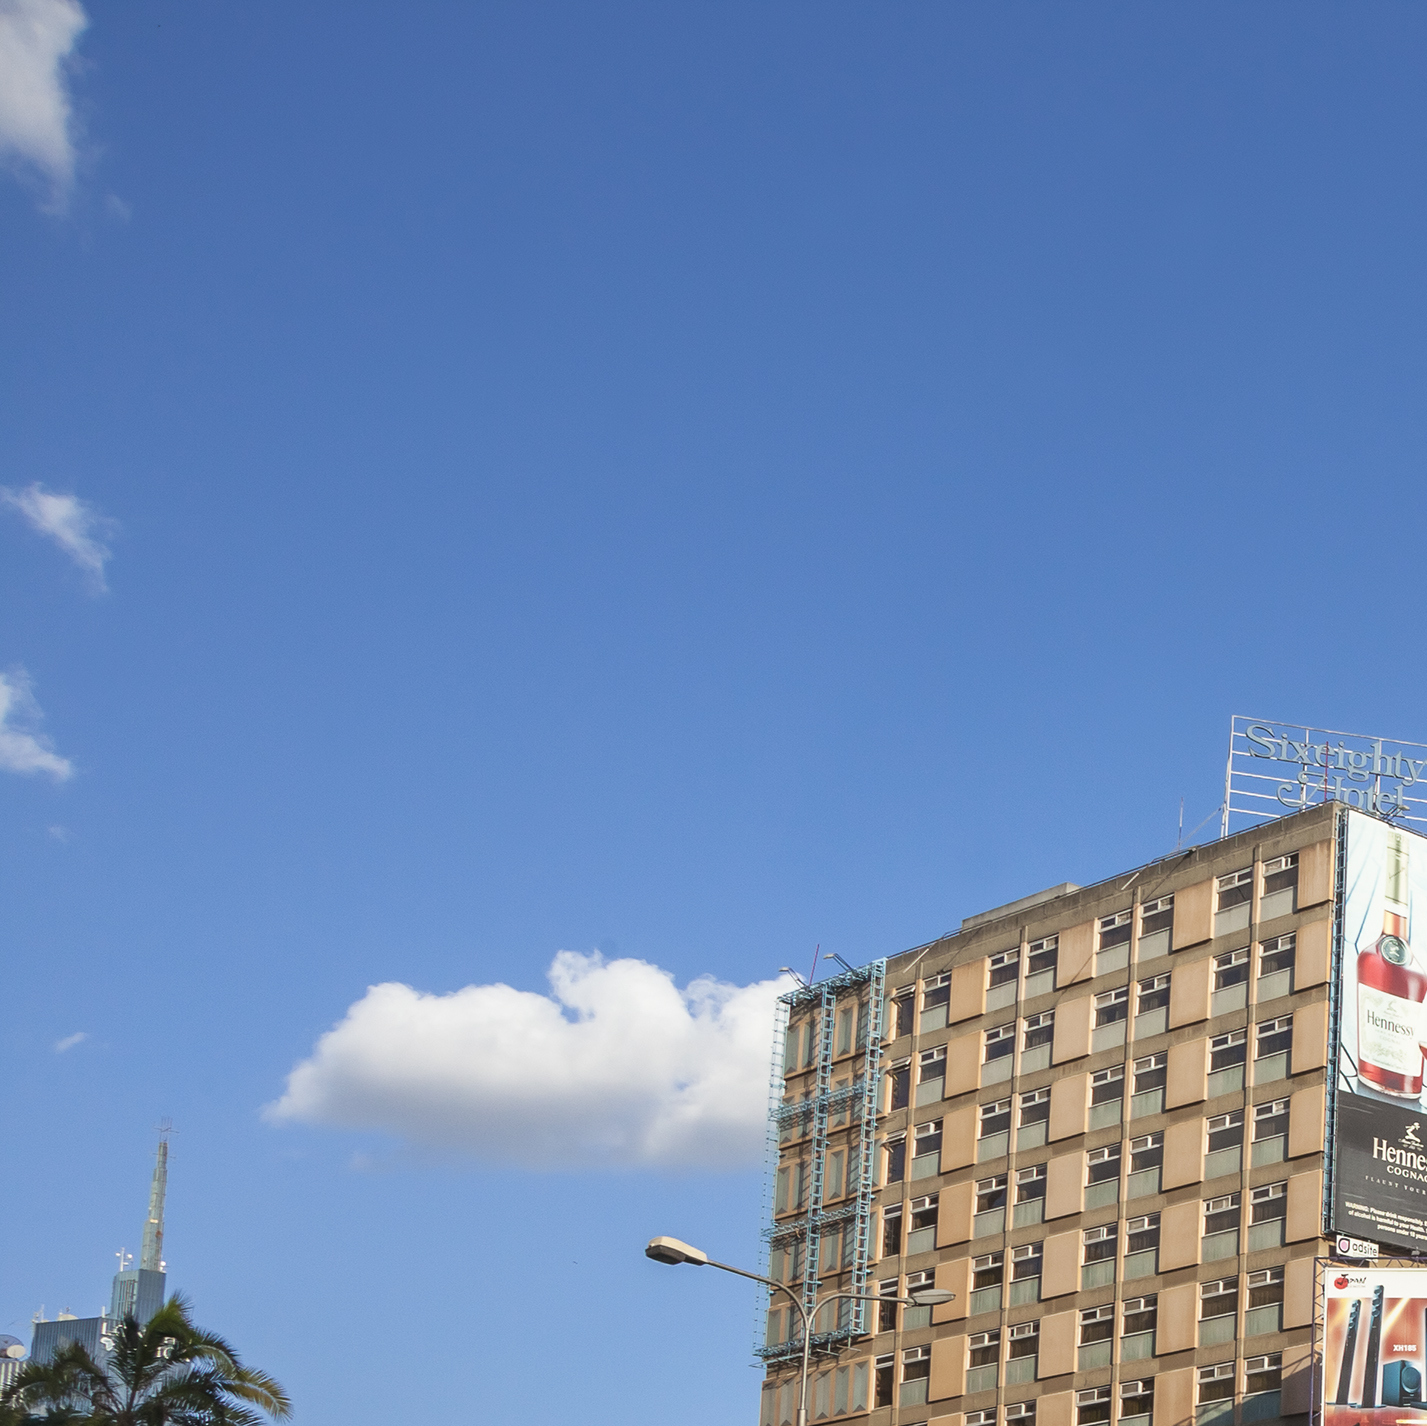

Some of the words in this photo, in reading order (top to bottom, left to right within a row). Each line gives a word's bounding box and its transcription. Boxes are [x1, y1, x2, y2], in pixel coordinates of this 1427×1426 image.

[1277, 771, 1404, 816] Hotel
[1367, 1009, 1416, 1039] Hennessy
[1365, 1175, 1399, 1188] FLAUNT
[1404, 1185, 1426, 1195] YOUR
[1352, 1242, 1378, 1256] adsite
